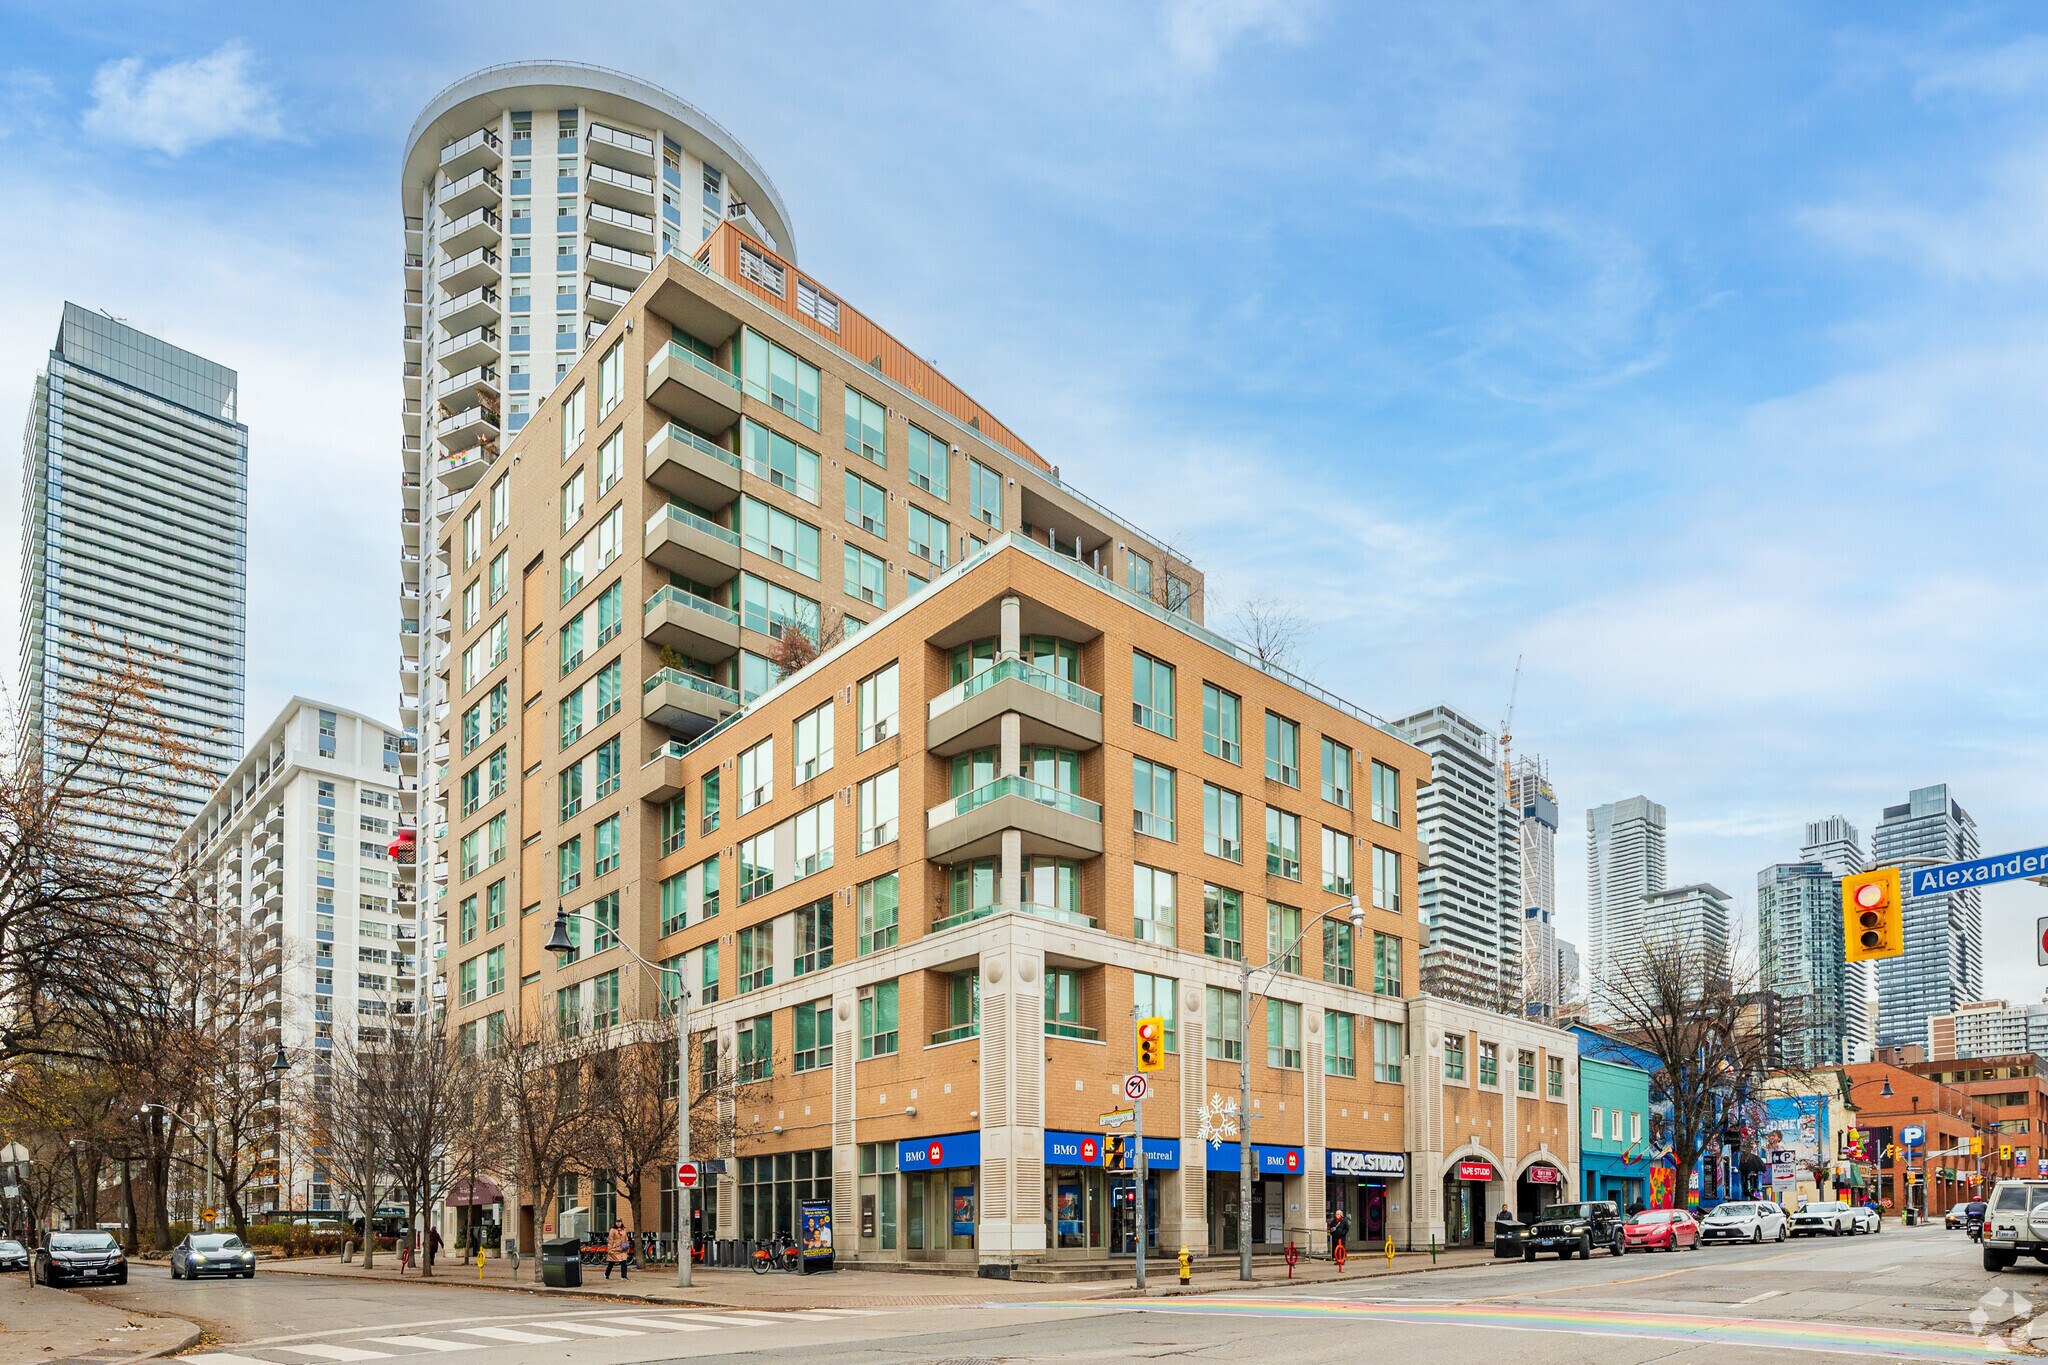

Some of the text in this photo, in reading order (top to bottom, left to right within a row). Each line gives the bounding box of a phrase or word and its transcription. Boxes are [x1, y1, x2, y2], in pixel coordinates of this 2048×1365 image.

[1920, 853, 2048, 891] Alexander
[1904, 1128, 1922, 1144] P
[905, 1150, 926, 1162] BMO
[1053, 1144, 1078, 1156] BMO
[1141, 1148, 1173, 1161] ntreal
[1267, 1156, 1285, 1166] BMO
[1331, 1152, 1404, 1172] PIZZA STUDIO
[1784, 1153, 1791, 1162] P
[1461, 1166, 1491, 1176] VAPE STUDIO
